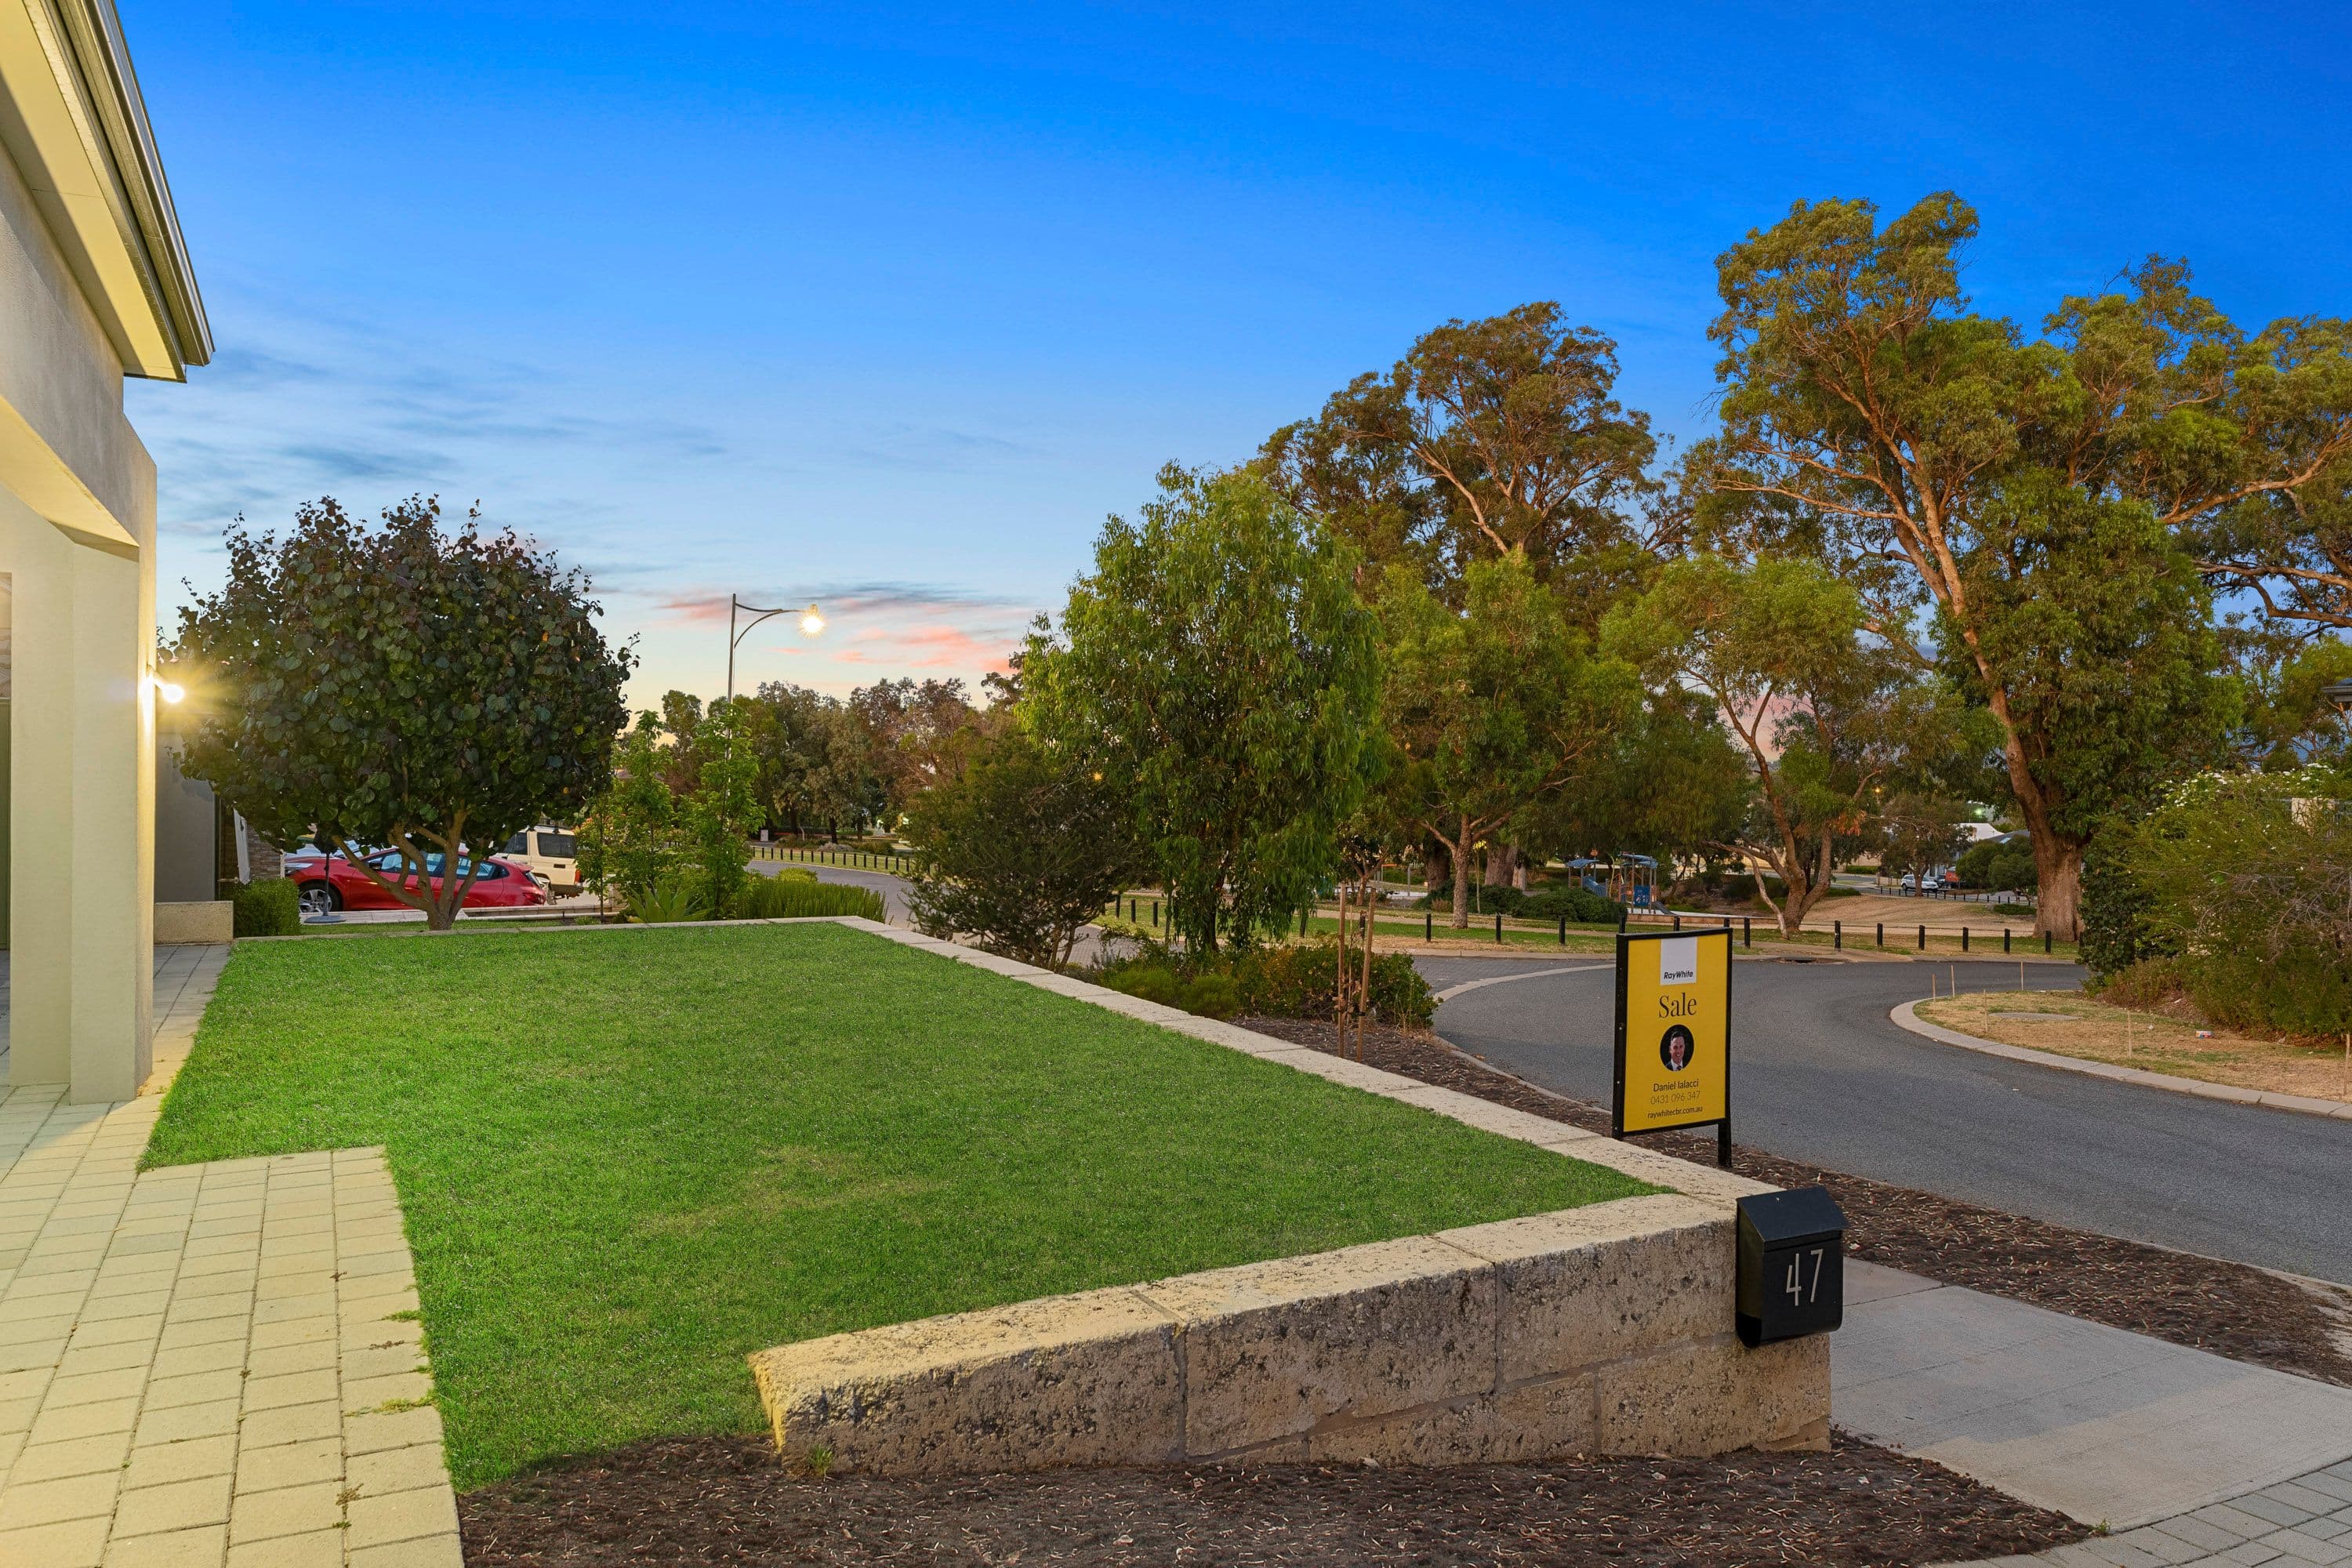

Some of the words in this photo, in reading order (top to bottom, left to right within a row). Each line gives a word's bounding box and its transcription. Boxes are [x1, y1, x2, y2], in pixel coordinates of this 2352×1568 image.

[1659, 992, 1697, 1018] Sale
[1653, 1081, 1676, 1092] Daniel
[1678, 1079, 1699, 1089] Ialacci
[1650, 1094, 1668, 1105] 0431
[1671, 1093, 1686, 1102] 096
[1687, 1091, 1700, 1100] 347
[1648, 1106, 1703, 1120] raywhitecbr.com.au
[1786, 1248, 1824, 1306] 47
